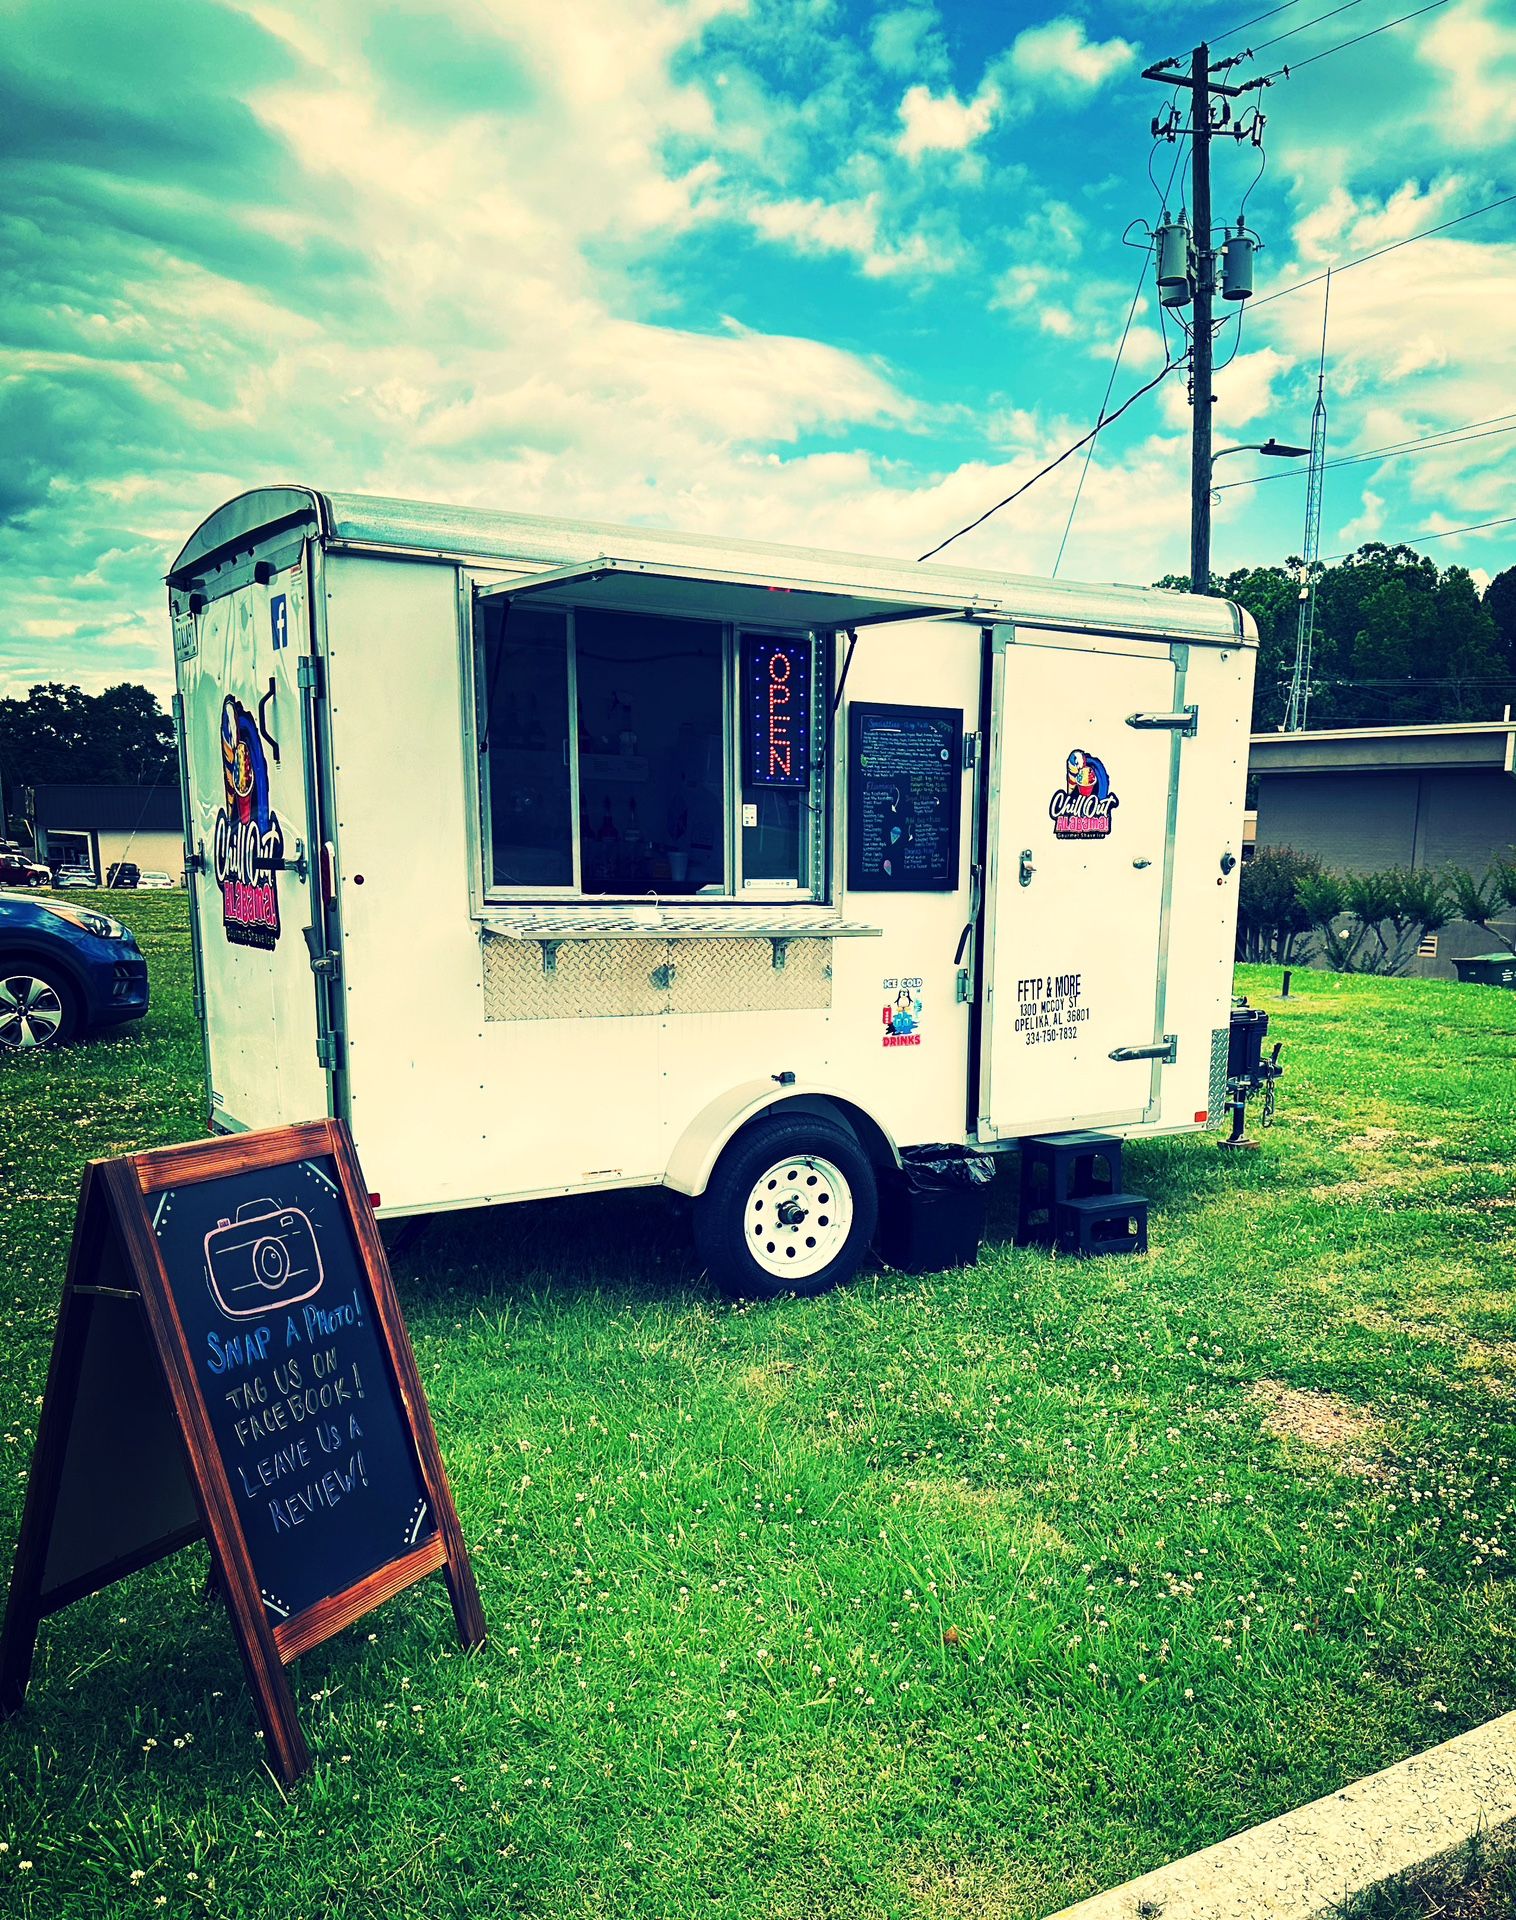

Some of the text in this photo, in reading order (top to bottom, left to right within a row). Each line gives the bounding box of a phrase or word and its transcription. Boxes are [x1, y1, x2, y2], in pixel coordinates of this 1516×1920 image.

[769, 653, 791, 776] OPEN
[1051, 792, 1117, 819] Chill Out
[216, 817, 246, 885] Chill
[883, 978, 923, 989] ICE COLD
[1017, 974, 1081, 1002] FFTP & MORE
[1020, 995, 1077, 1016] 1300 MCCOY ST
[1053, 1012, 1063, 1025] AL
[1066, 1008, 1089, 1022] 36801
[883, 1035, 921, 1047] DRINKS
[1025, 1026, 1077, 1045] 334-750-7832
[207, 1326, 270, 1374] SNAP
[286, 1316, 301, 1347] A
[226, 1347, 337, 1410] TAG US ON
[238, 1438, 311, 1498] LEAVE
[350, 1413, 363, 1439] A
[268, 1450, 369, 1533] REVIEW!
